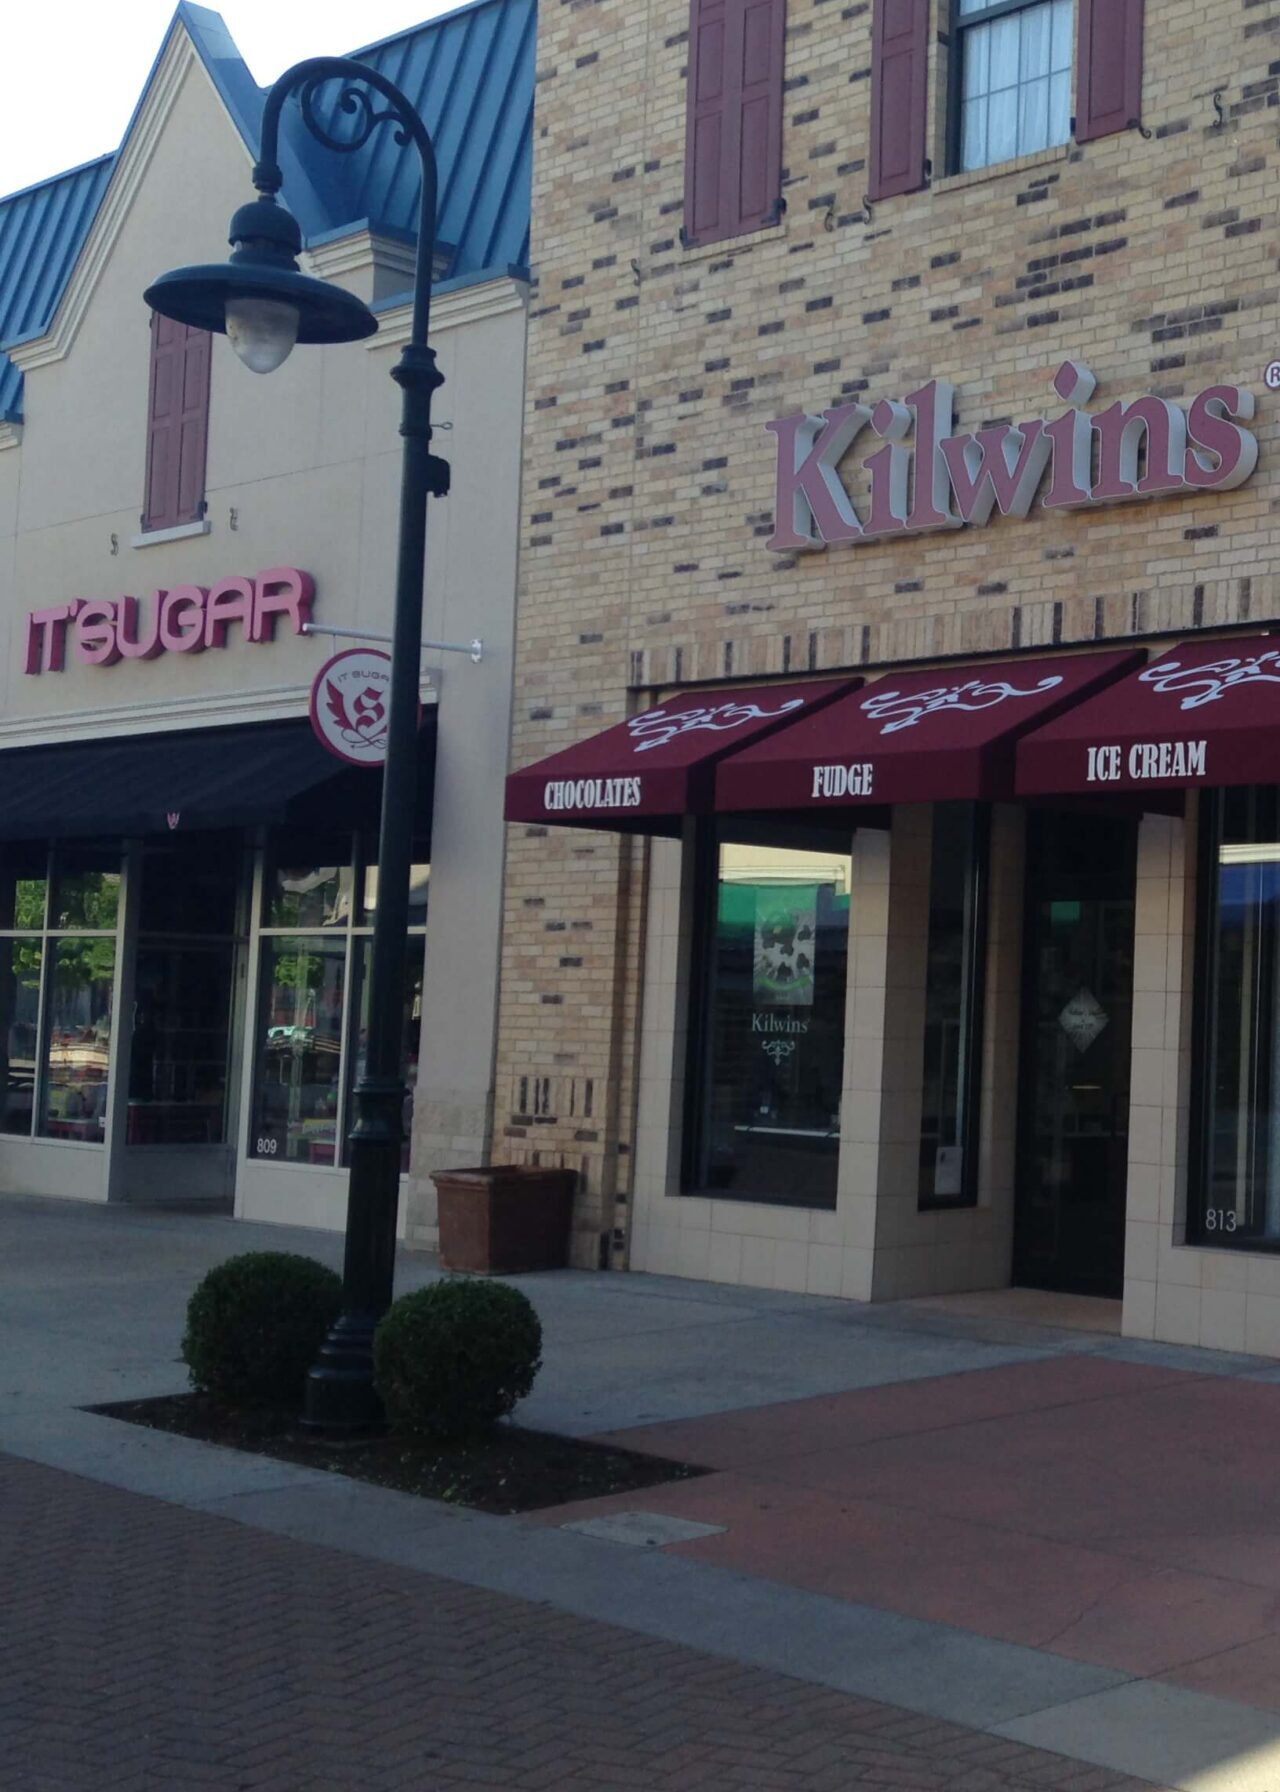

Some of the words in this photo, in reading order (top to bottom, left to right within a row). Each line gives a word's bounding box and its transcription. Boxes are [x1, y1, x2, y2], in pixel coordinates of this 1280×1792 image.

[765, 360, 1258, 552] Kilwins
[23, 567, 316, 676] IT'SUGAR
[351, 670, 391, 682] SUGA
[1086, 745, 1125, 782] ICE
[1128, 740, 1207, 779] CREAM
[543, 776, 641, 811] CHOCOLATES
[811, 763, 873, 798] FUDGE
[752, 1012, 808, 1034] Kilwins
[256, 1137, 277, 1154] 809
[1205, 1209, 1237, 1232] 813
